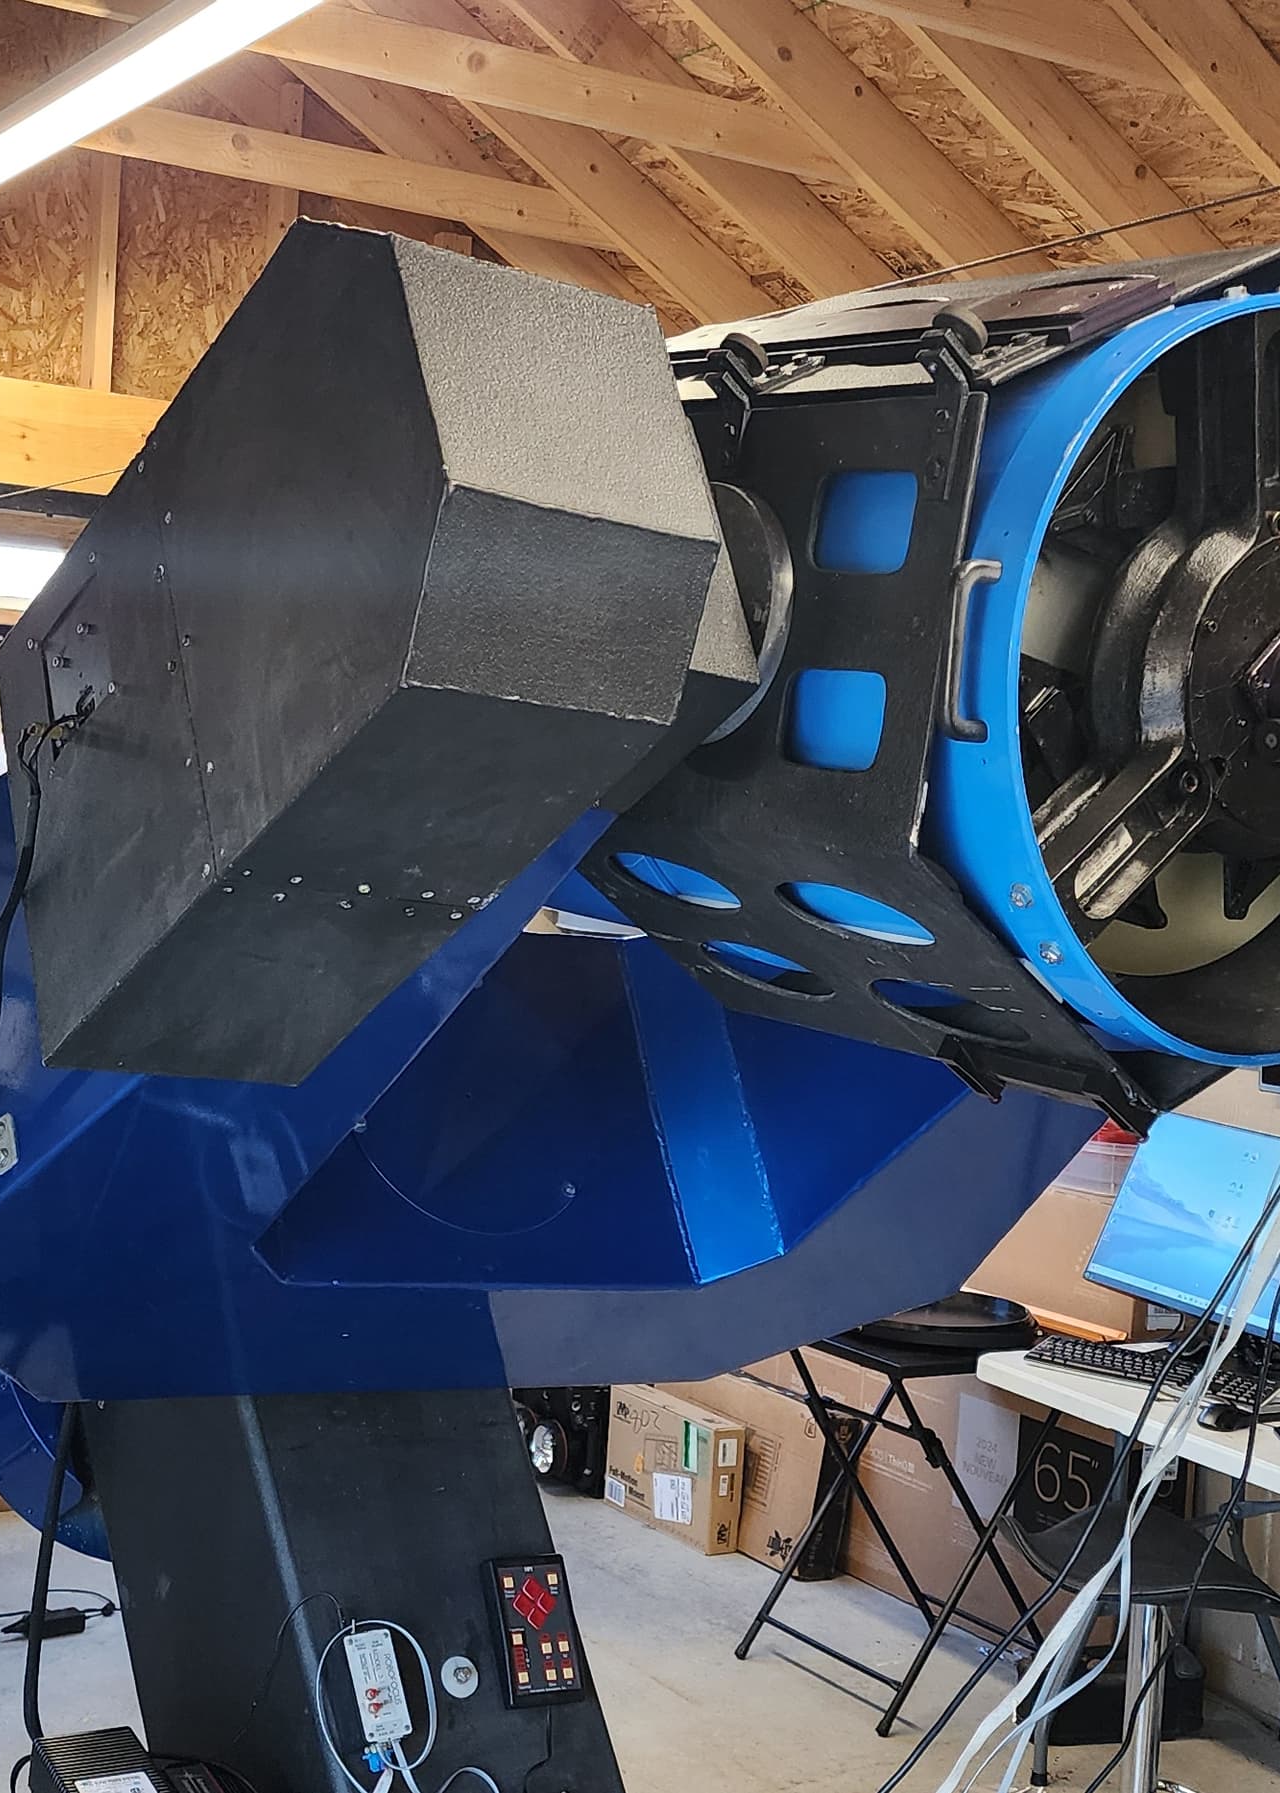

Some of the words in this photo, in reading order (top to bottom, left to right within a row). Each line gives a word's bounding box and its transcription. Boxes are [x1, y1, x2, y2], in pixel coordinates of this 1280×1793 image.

[976, 1437, 999, 1454] 2024
[962, 1460, 1008, 1488] NOUVEAU
[975, 1453, 998, 1470] NEW
[1034, 1442, 1100, 1513] 65"
[383, 1653, 402, 1705] ROBOFOCUS
